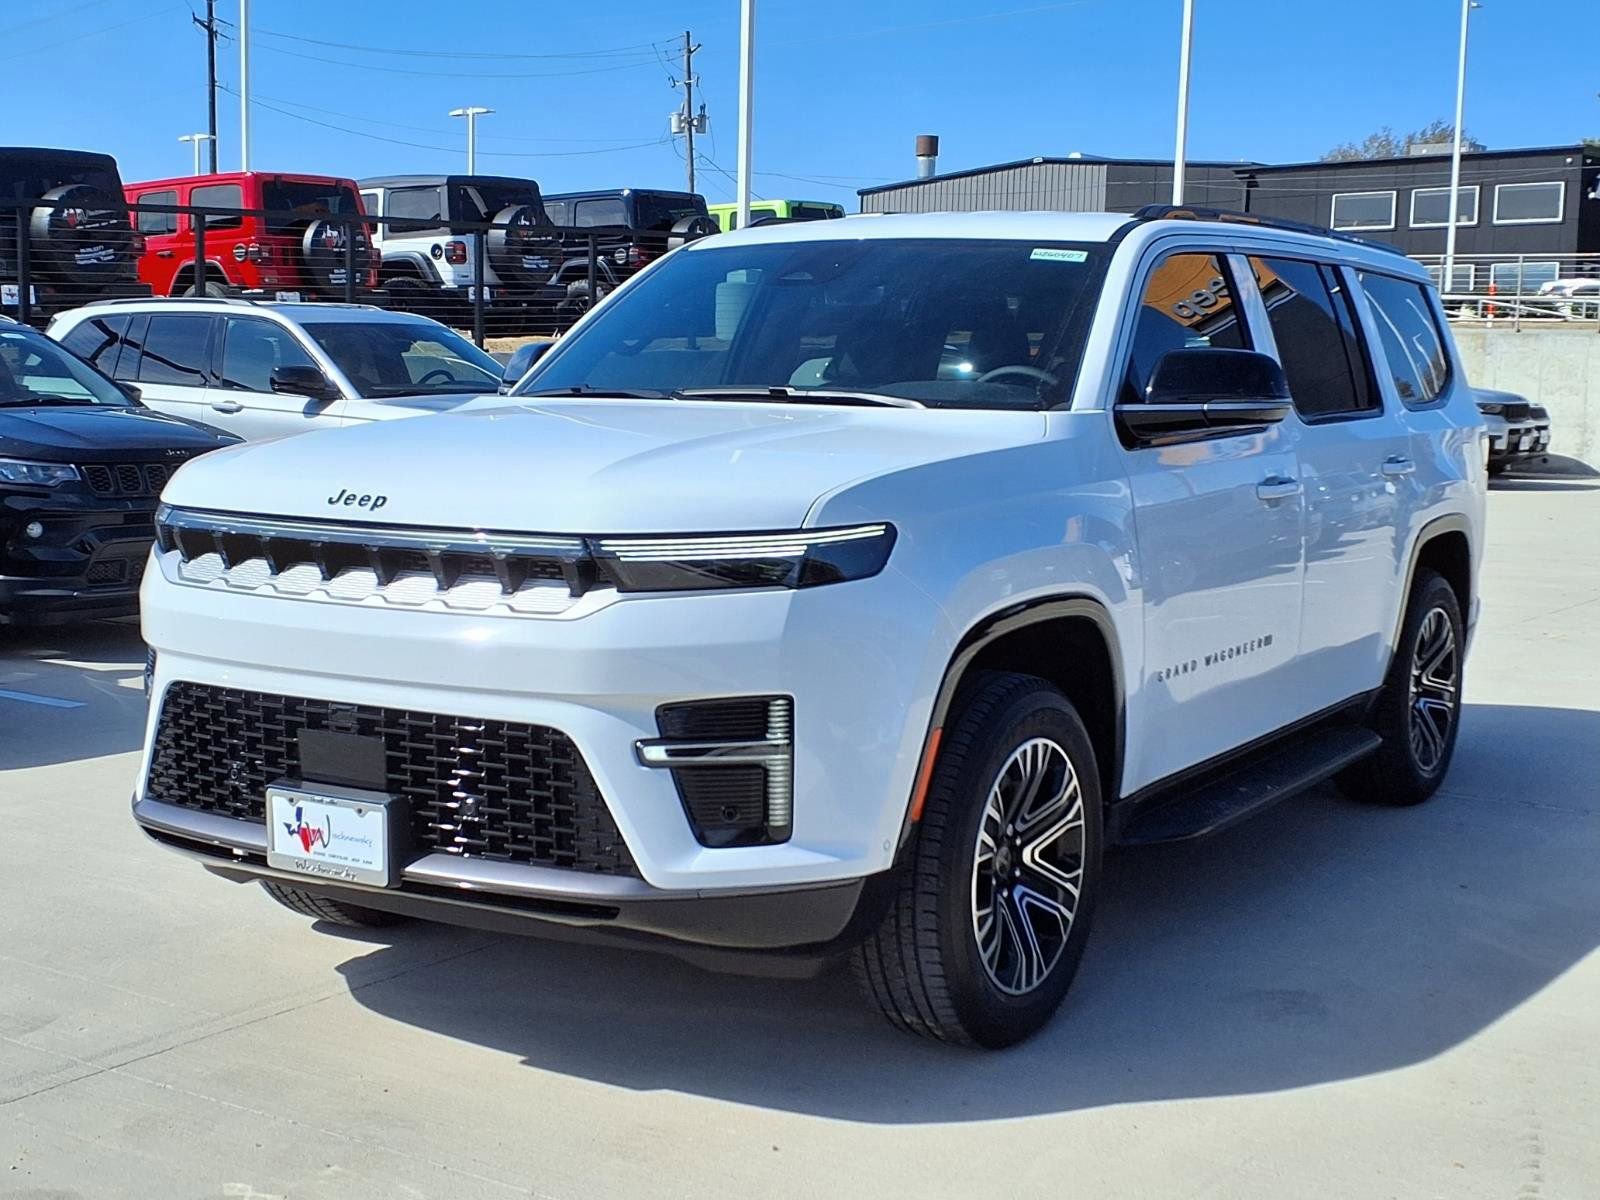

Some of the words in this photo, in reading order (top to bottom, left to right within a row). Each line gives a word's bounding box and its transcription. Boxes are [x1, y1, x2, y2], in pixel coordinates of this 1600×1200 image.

[328, 489, 388, 511] Jeep
[1157, 659, 1197, 682] GRAND
[1204, 638, 1263, 666] WAGONEER
